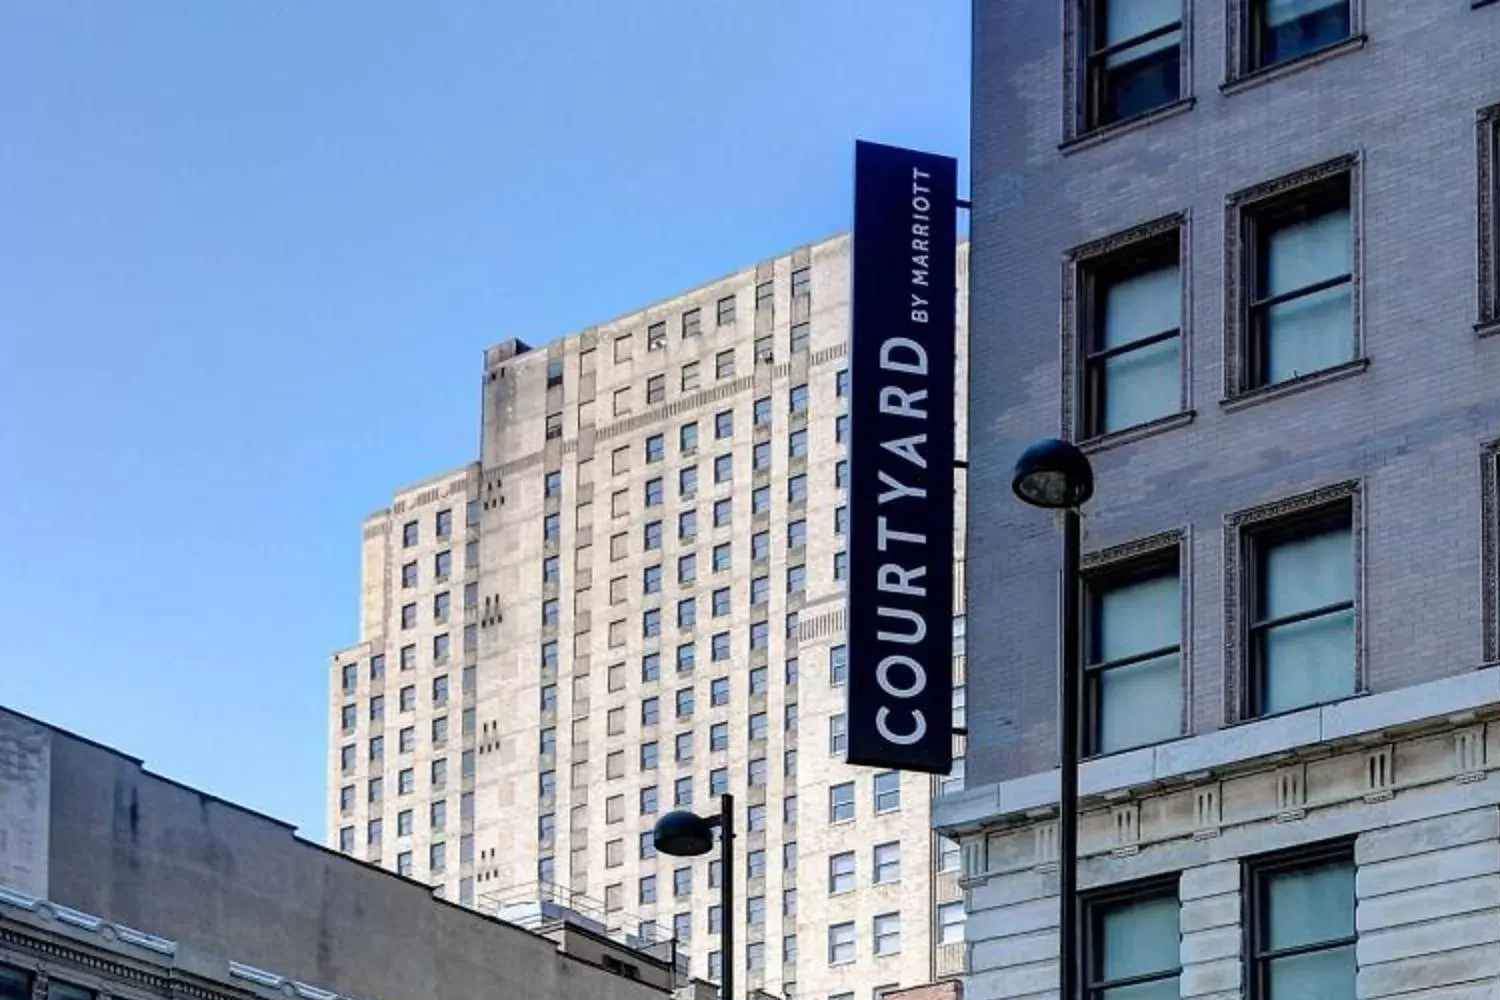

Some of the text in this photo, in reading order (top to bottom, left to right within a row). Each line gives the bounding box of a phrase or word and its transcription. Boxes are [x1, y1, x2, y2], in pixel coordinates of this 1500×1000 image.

[875, 167, 932, 746] COURTYARD BY MARRIOTT
